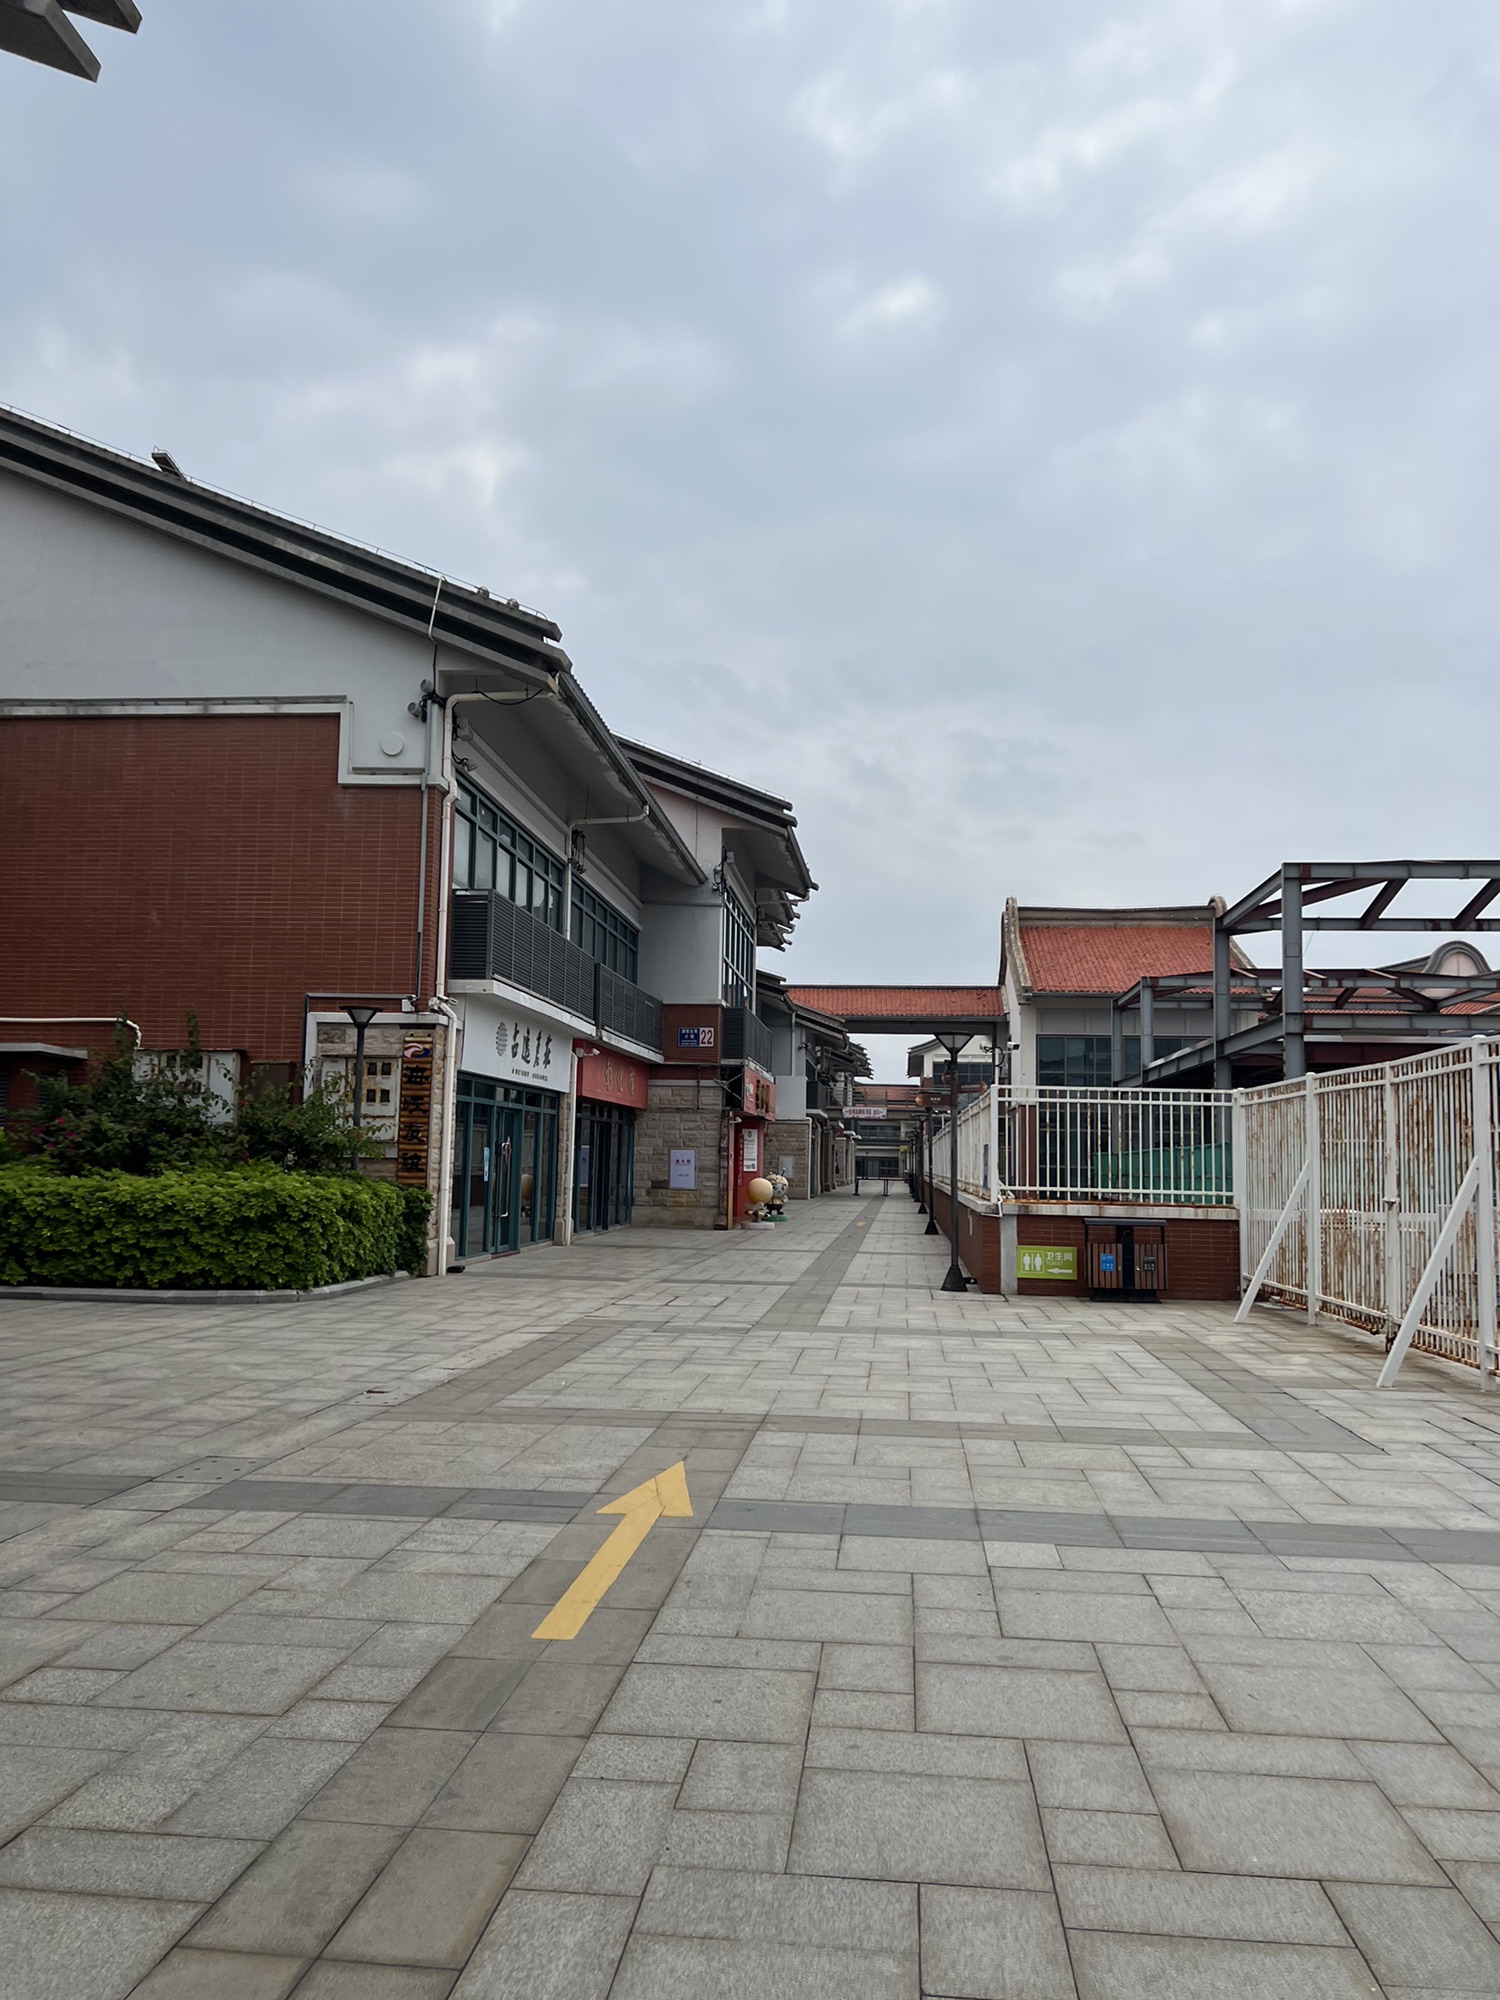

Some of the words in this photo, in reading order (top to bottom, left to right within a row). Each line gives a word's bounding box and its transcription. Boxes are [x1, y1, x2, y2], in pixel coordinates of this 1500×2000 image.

[700, 1030, 713, 1045] 22
[1046, 1251, 1073, 1262] 卫生间
